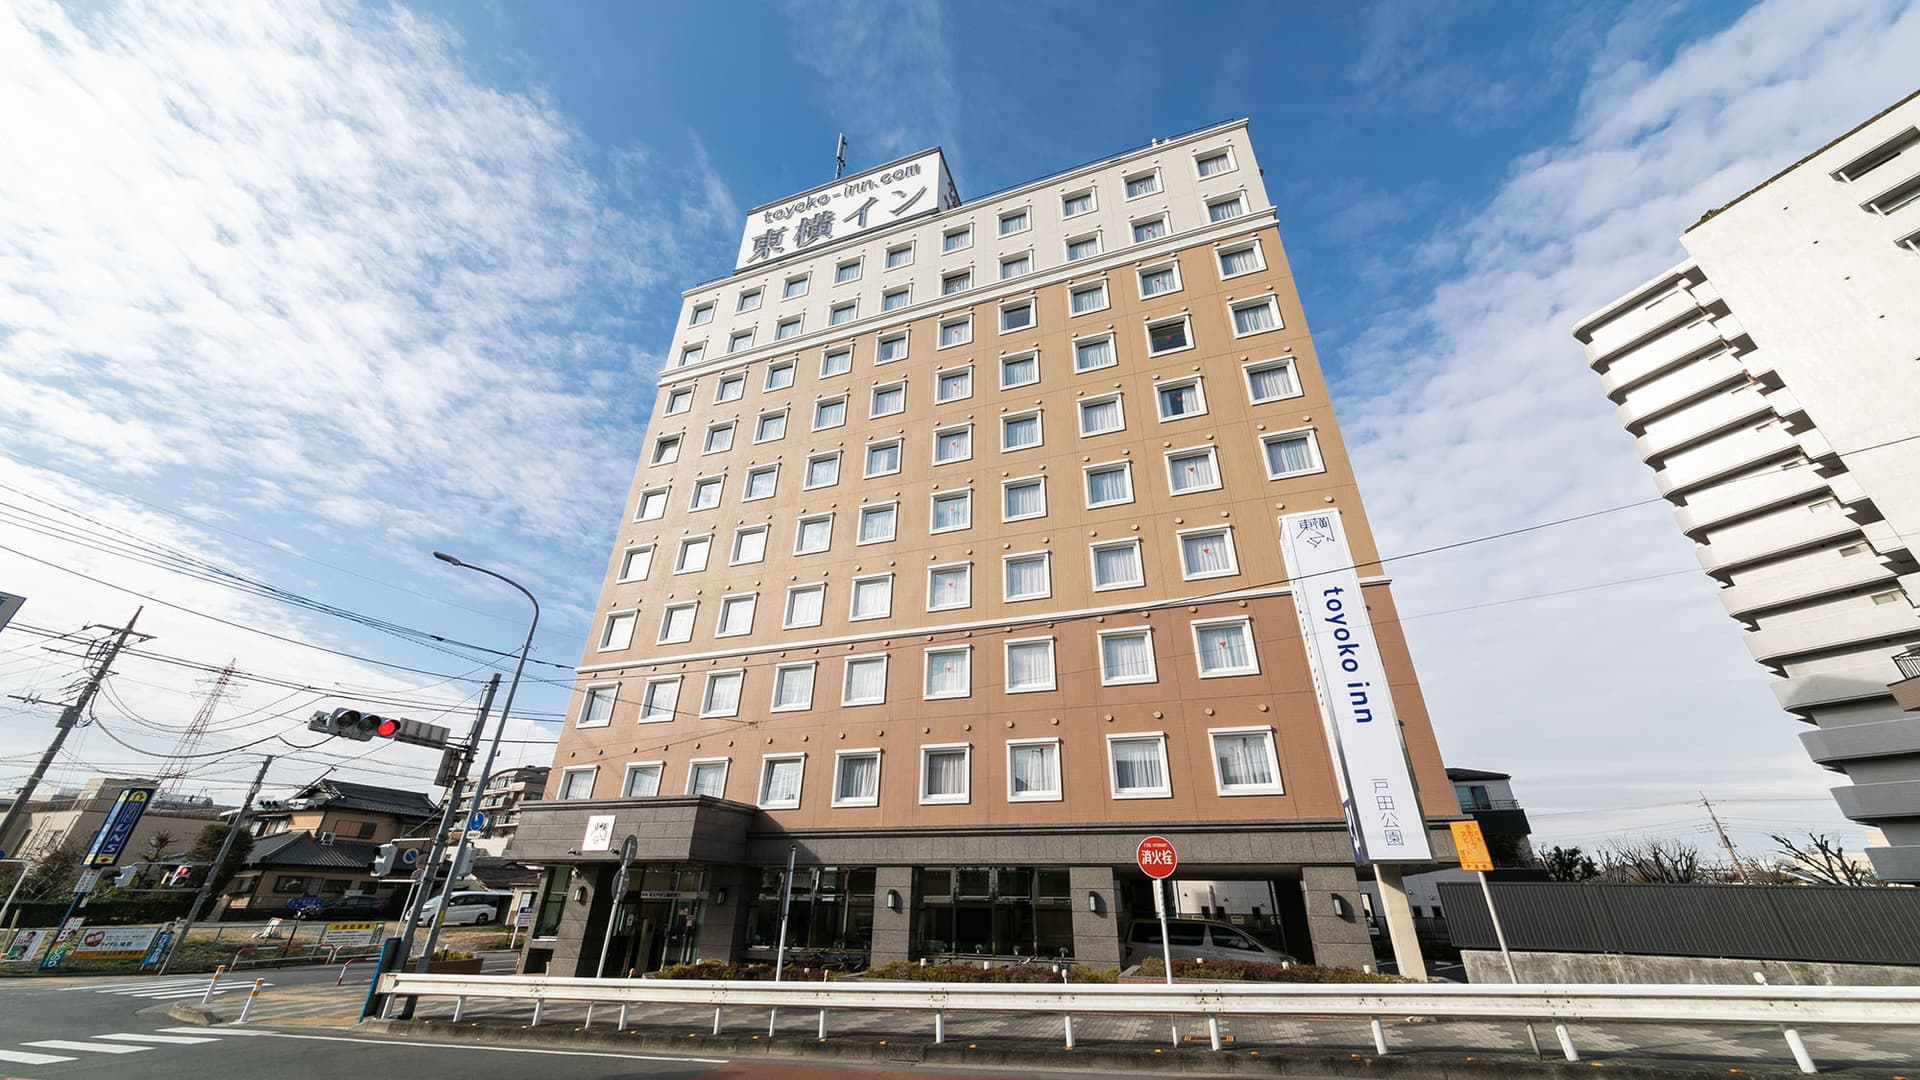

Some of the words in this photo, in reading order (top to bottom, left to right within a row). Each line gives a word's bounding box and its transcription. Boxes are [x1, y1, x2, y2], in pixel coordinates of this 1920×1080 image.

[747, 185, 928, 263] 東横イン
[763, 163, 921, 224] toyoko-inn.com
[1323, 586, 1360, 673] toyoko
[1347, 682, 1373, 724] inn
[1370, 778, 1405, 846] 戸田公園
[1141, 849, 1173, 865] 消火栓
